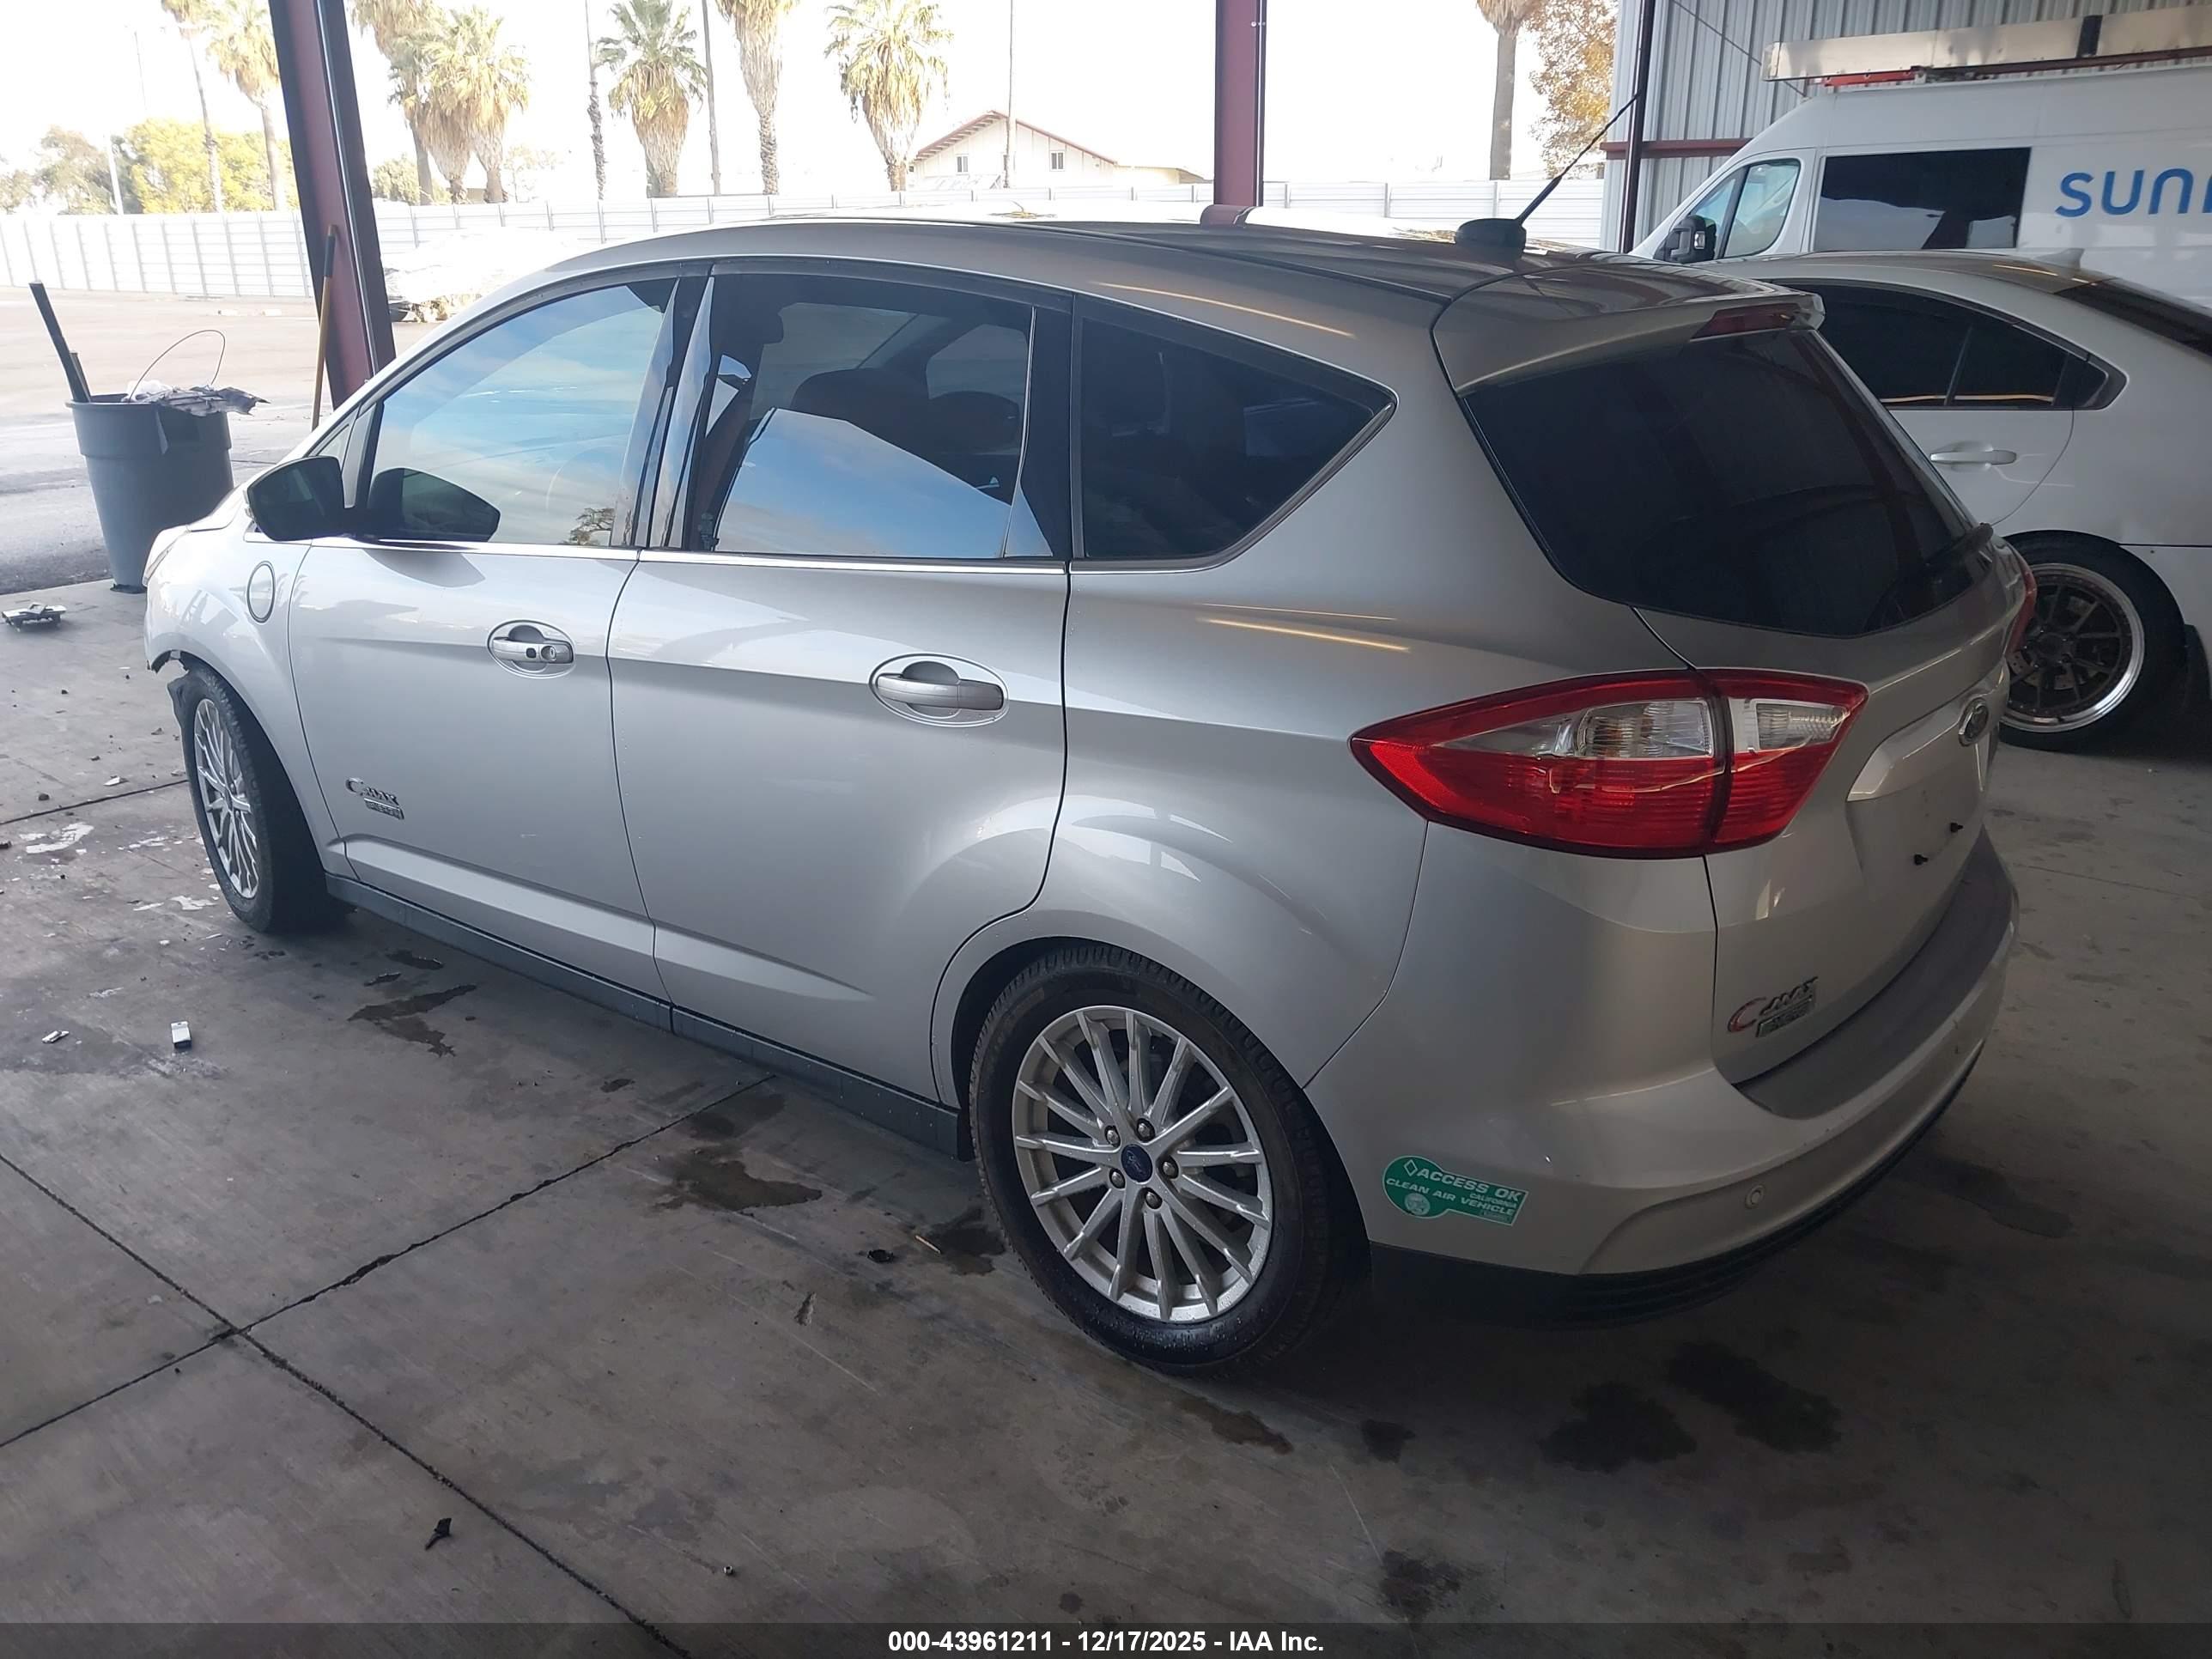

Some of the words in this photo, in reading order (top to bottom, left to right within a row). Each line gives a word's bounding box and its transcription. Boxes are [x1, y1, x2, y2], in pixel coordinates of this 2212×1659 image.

[2055, 168, 2212, 217] sun
[1386, 1177, 1430, 1194] CLEAN
[1432, 1190, 1456, 1202] AIR
[1461, 1197, 1516, 1216] VEHICLE
[1417, 1168, 1490, 1194] ACCESS
[1494, 1188, 1523, 1202] OK
